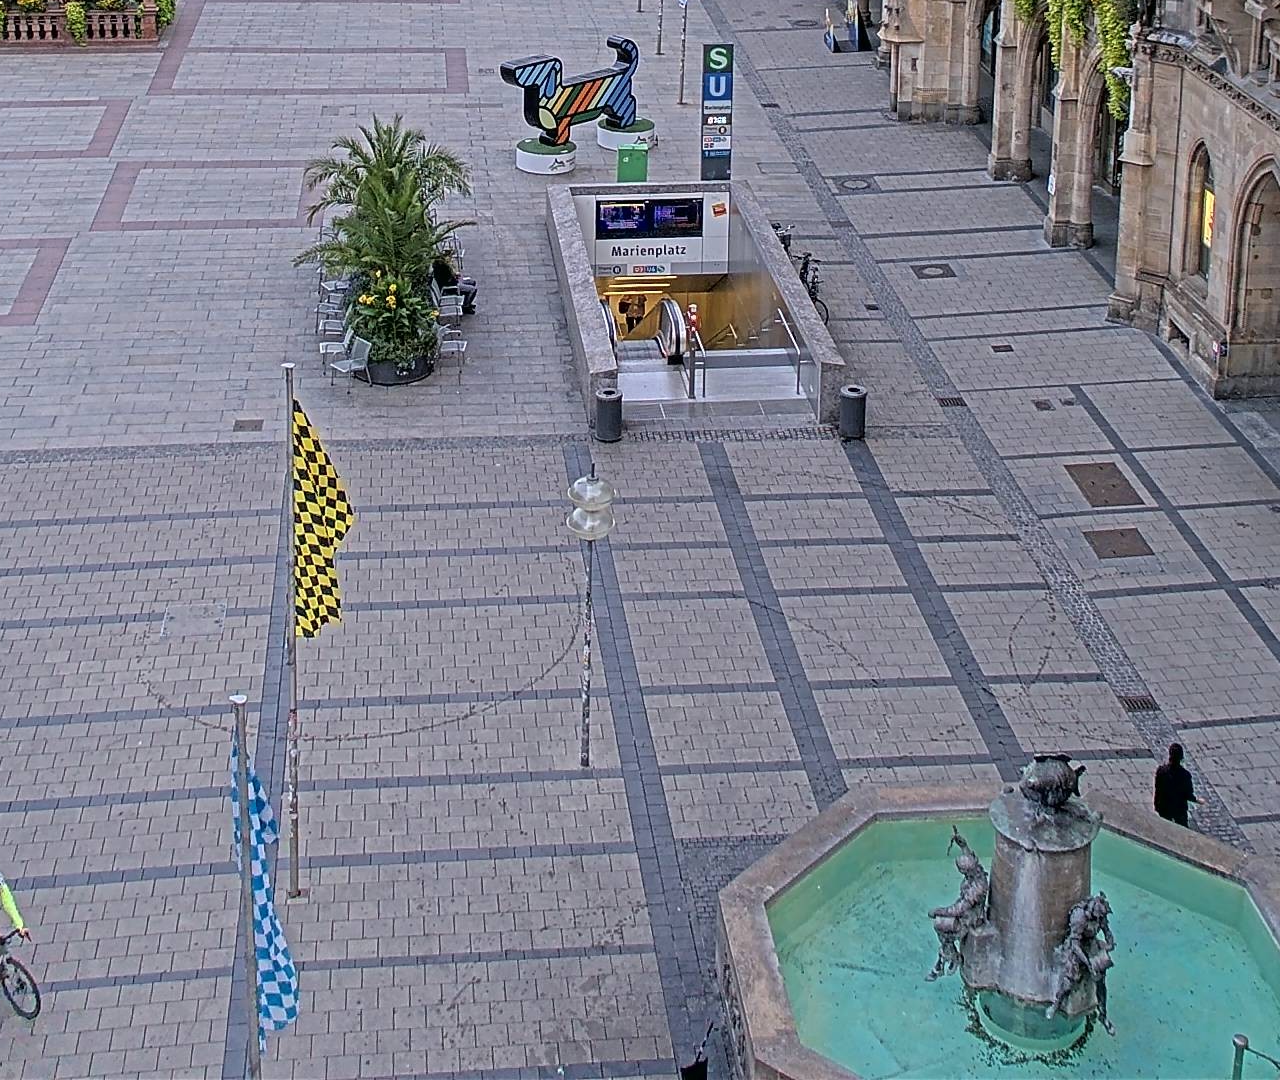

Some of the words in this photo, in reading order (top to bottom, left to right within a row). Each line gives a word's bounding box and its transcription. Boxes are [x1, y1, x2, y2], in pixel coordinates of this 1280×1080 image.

[709, 48, 728, 69] S
[709, 77, 726, 96] U
[611, 245, 687, 257] Marienplatz
